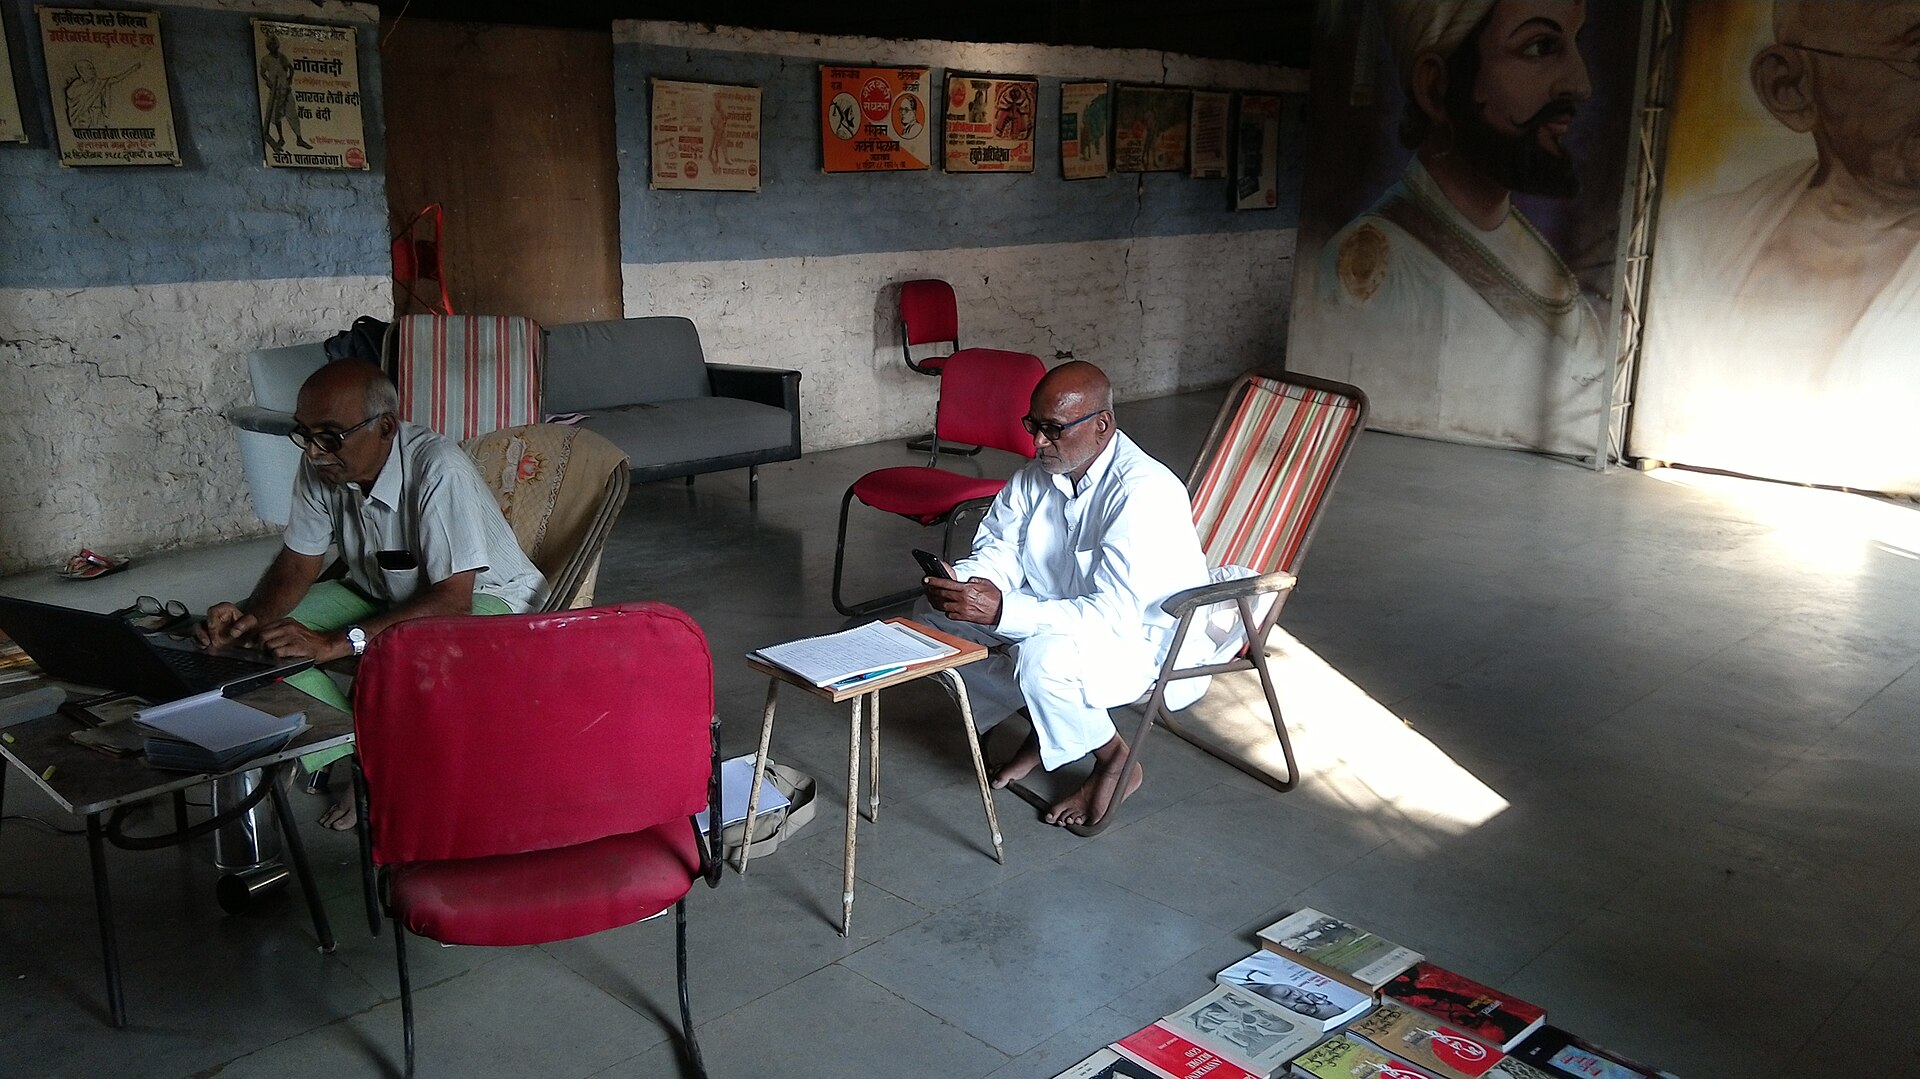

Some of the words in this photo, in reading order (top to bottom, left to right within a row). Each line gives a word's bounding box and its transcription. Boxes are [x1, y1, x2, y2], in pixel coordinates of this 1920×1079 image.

[327, 90, 344, 104] लेवी
[344, 91, 360, 106] बंदी
[863, 99, 890, 112] संघटना
[316, 107, 332, 121] बंदी
[273, 151, 293, 165] चलो
[1184, 1047, 1203, 1059] GOD
[1186, 1052, 1213, 1070] BEFORE
